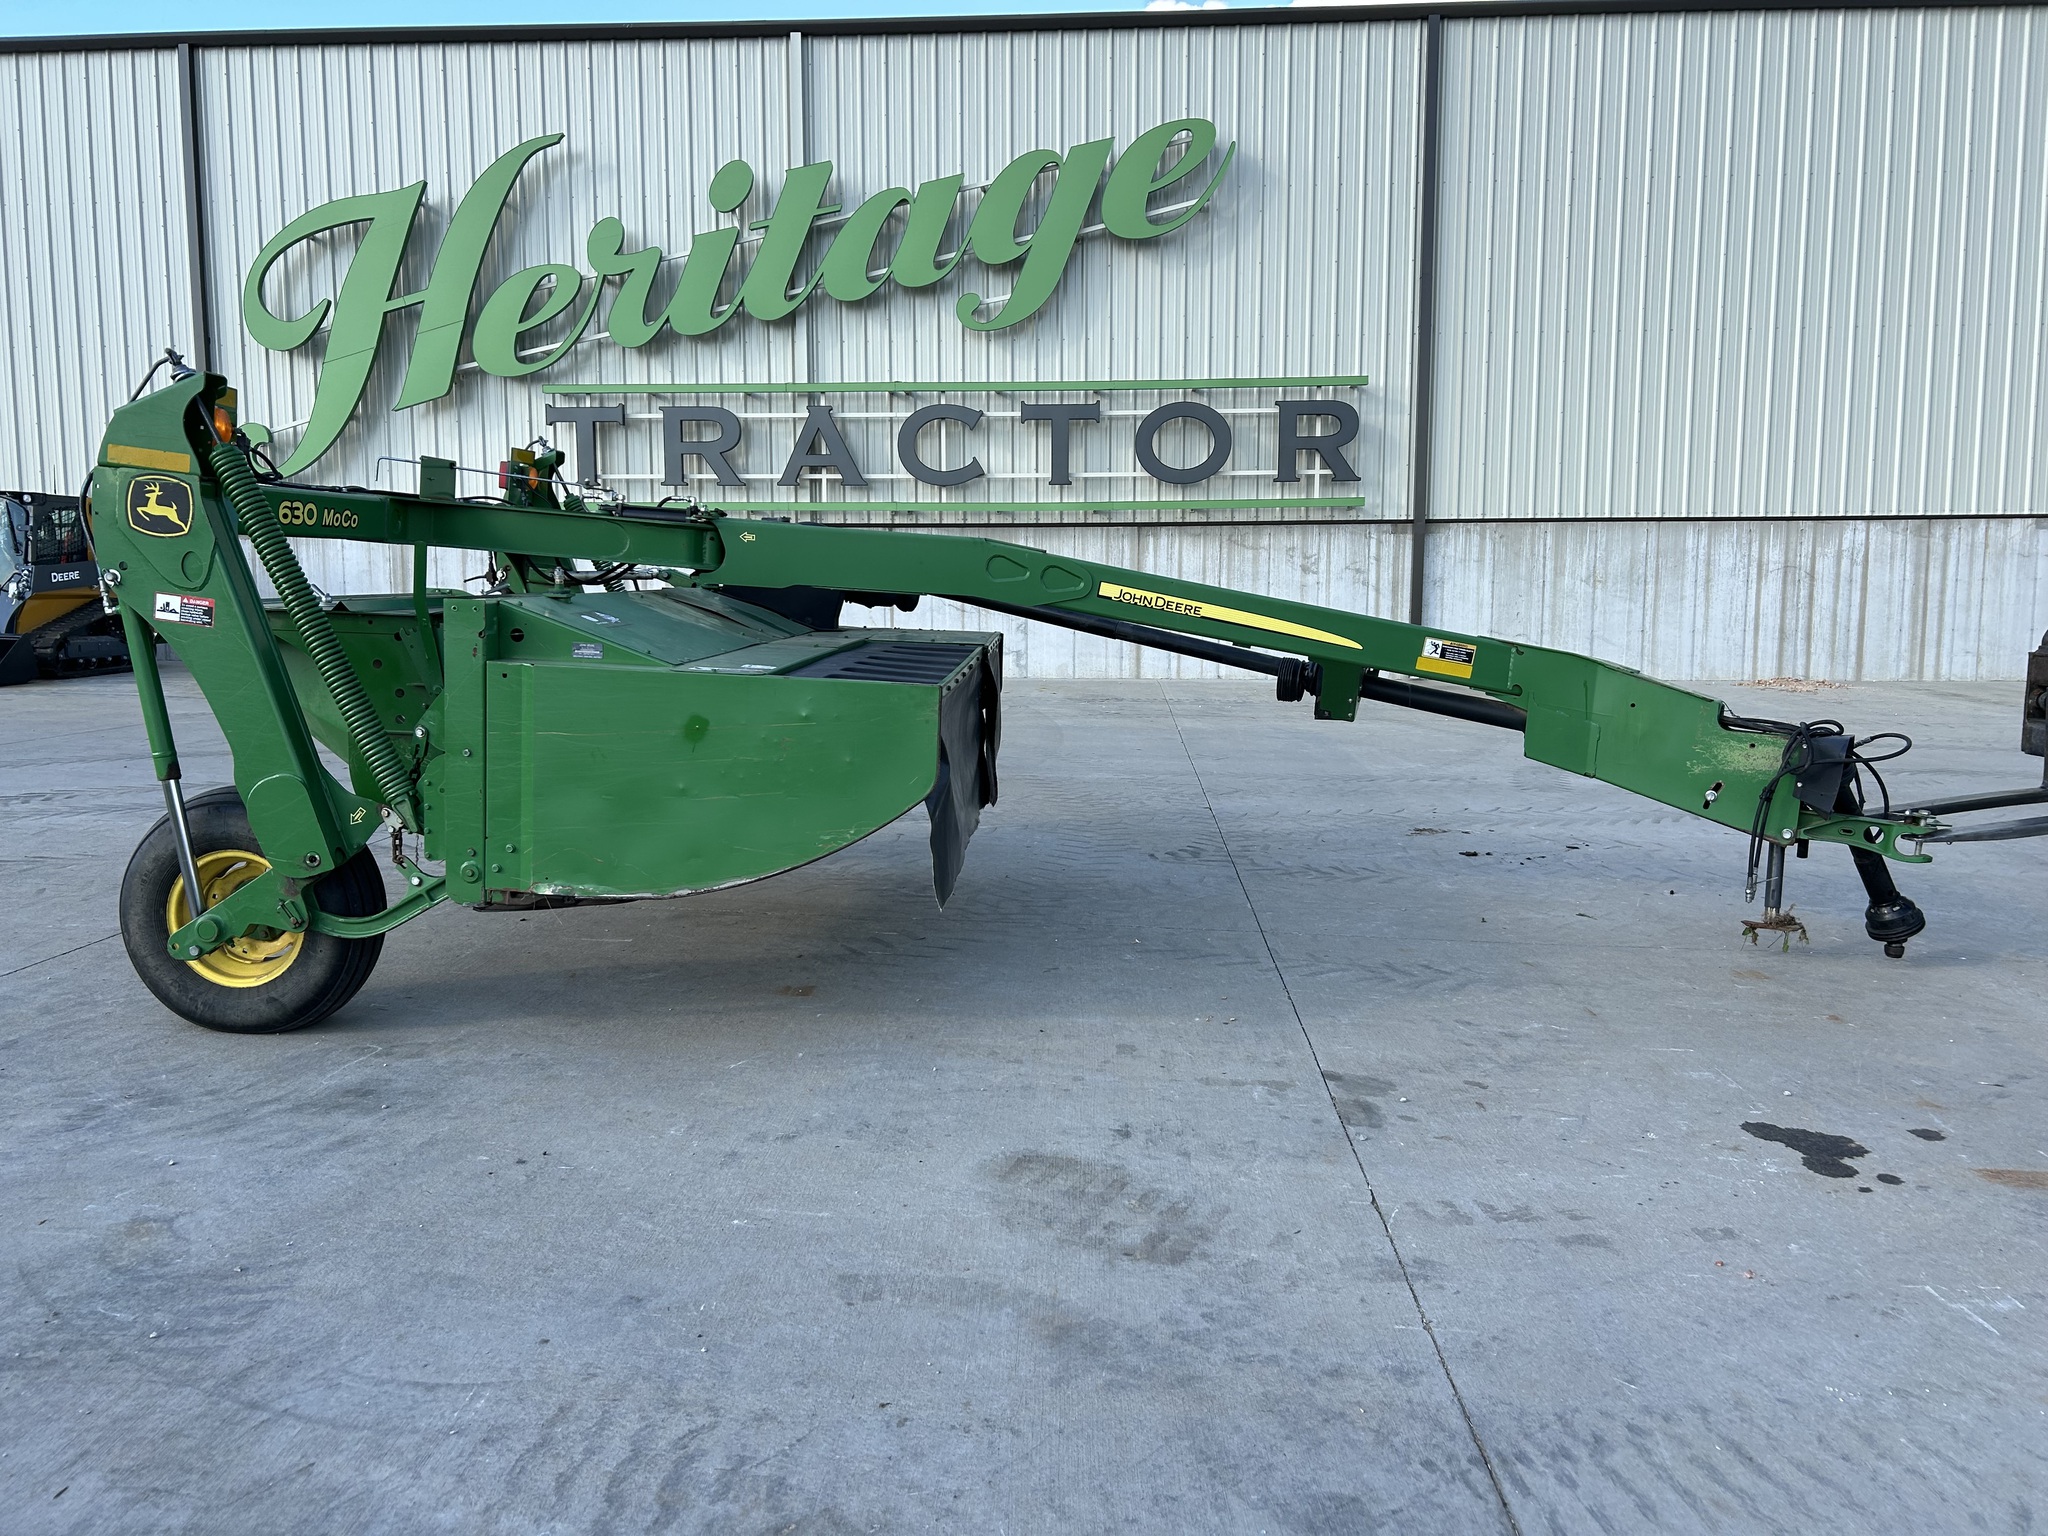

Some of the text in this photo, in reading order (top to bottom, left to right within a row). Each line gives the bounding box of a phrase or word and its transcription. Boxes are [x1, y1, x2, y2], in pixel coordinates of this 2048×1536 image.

[240, 118, 1236, 477] Heritage
[545, 400, 1362, 486] TRACTOR
[279, 501, 359, 528] 630 MoCo
[51, 571, 80, 583] DEERE
[1114, 589, 1203, 616] JOHN DEERE
